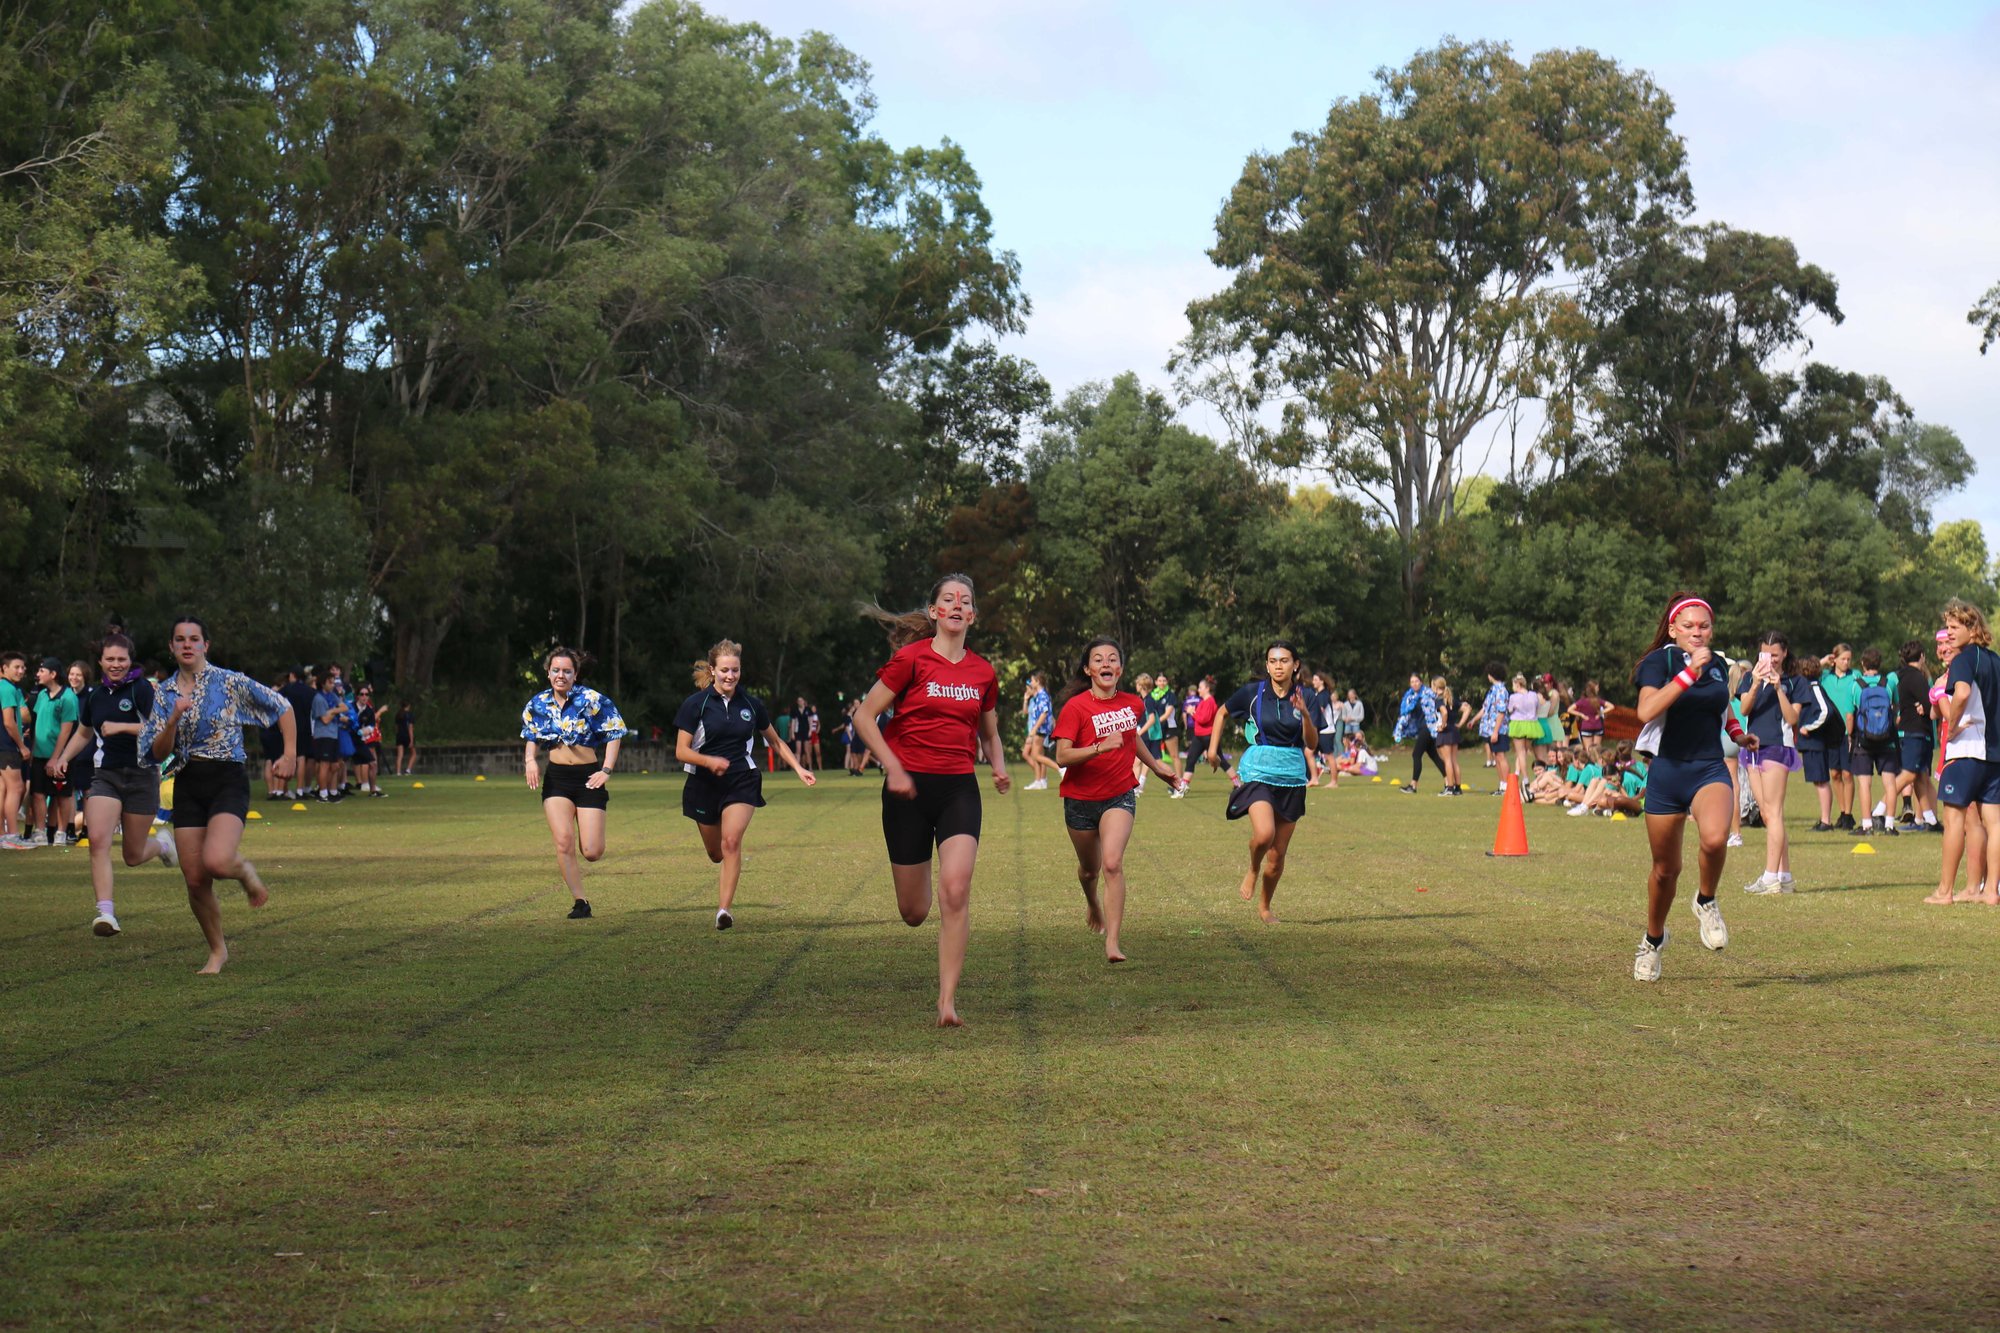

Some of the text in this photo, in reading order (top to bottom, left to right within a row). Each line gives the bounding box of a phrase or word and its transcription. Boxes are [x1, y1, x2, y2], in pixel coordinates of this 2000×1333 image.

[926, 681, 980, 701] Knights
[1097, 725, 1114, 737] JUST
[1114, 721, 1126, 731] DO
